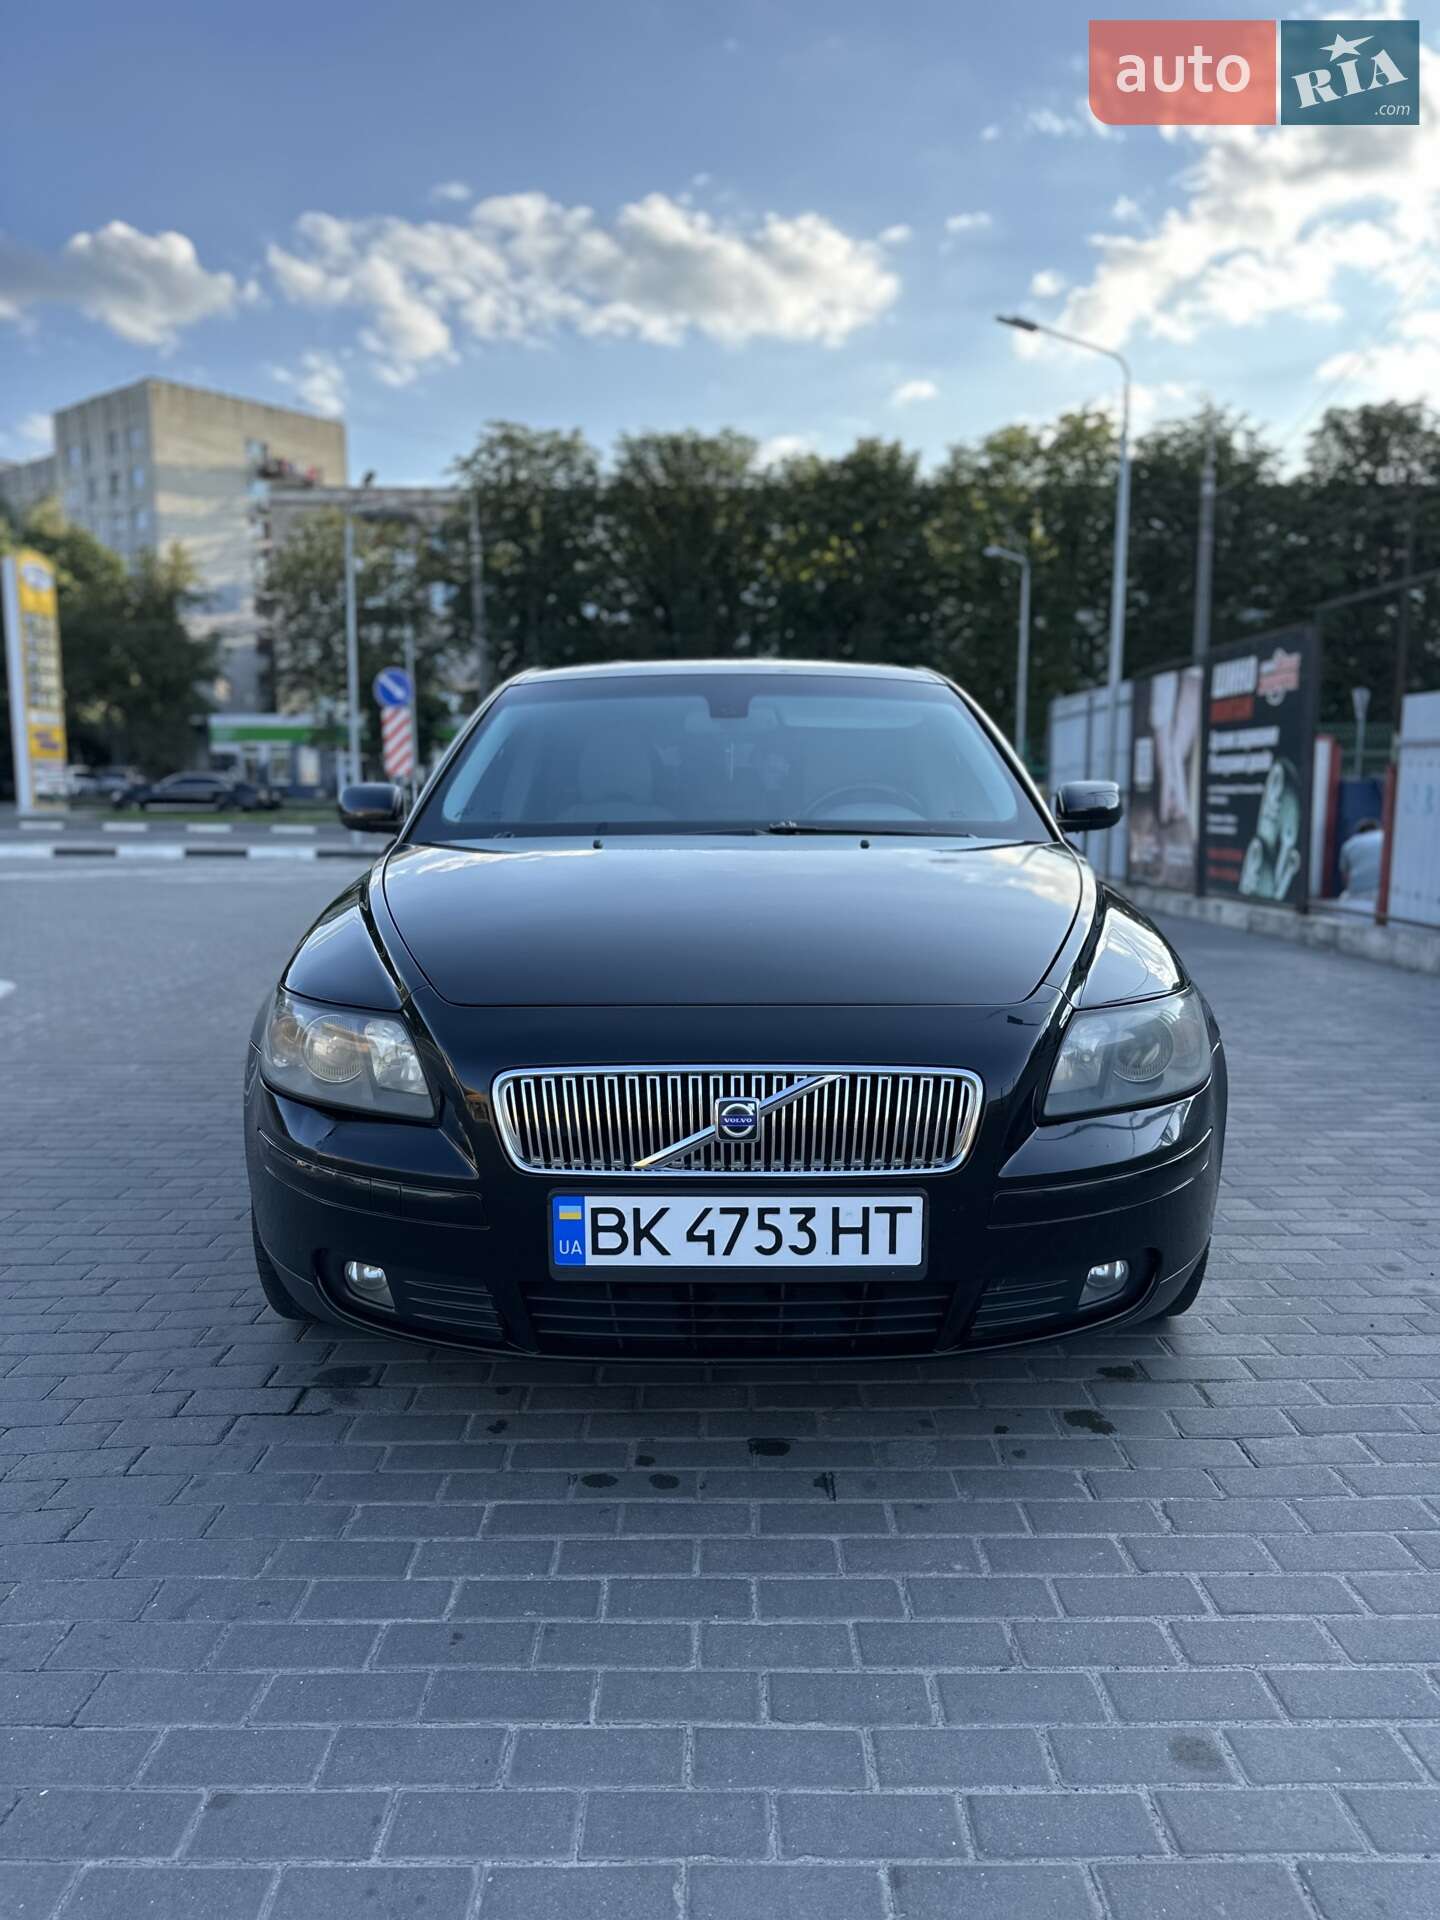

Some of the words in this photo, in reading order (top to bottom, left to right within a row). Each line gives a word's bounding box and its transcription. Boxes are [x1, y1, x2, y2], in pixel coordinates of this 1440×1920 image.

[559, 1239, 582, 1255] UA
[590, 1206, 672, 1256] BK
[686, 1207, 817, 1256] 4753
[831, 1206, 913, 1256] HT
